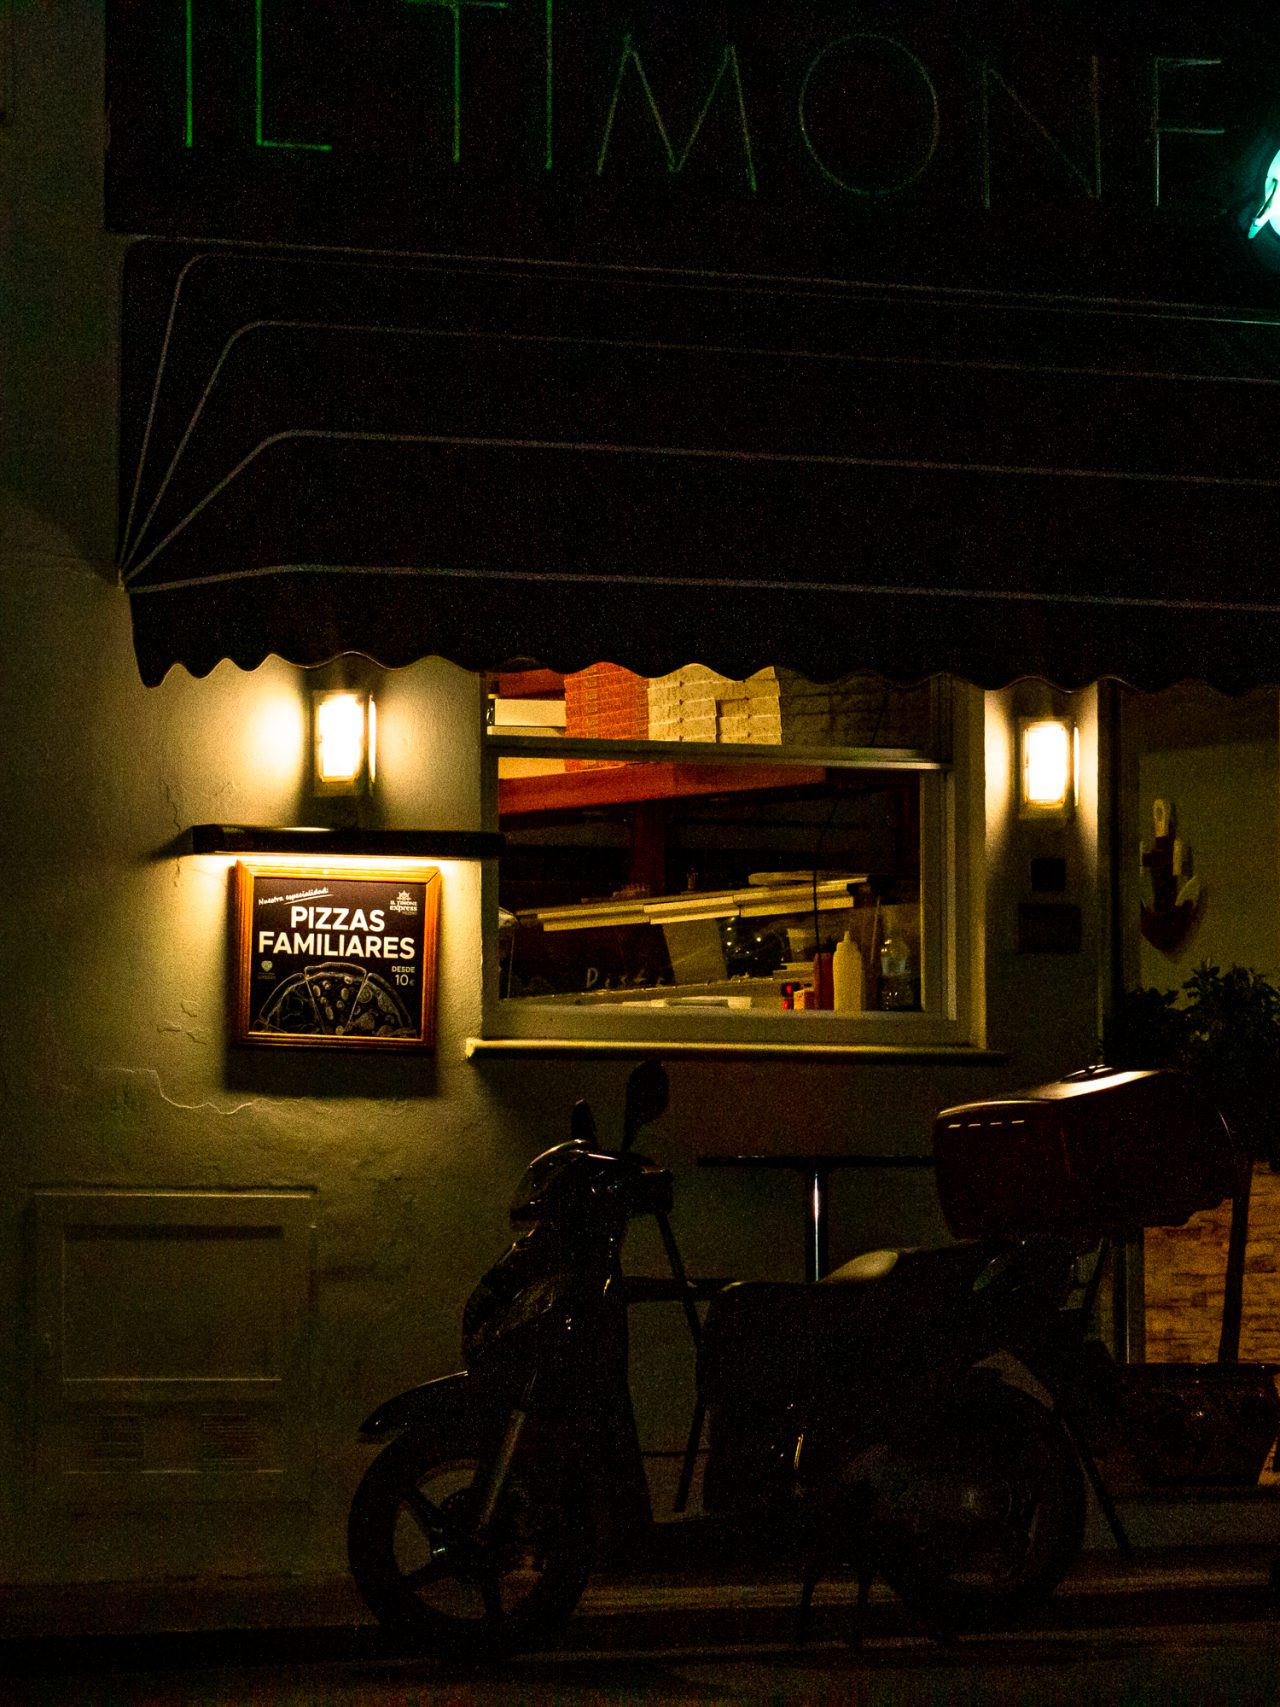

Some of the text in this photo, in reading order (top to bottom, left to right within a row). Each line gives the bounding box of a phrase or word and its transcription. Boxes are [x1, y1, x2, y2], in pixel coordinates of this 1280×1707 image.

[290, 905, 385, 932] PIZZAS
[258, 931, 415, 959] FAMILIARES
[391, 965, 416, 974] DESDE
